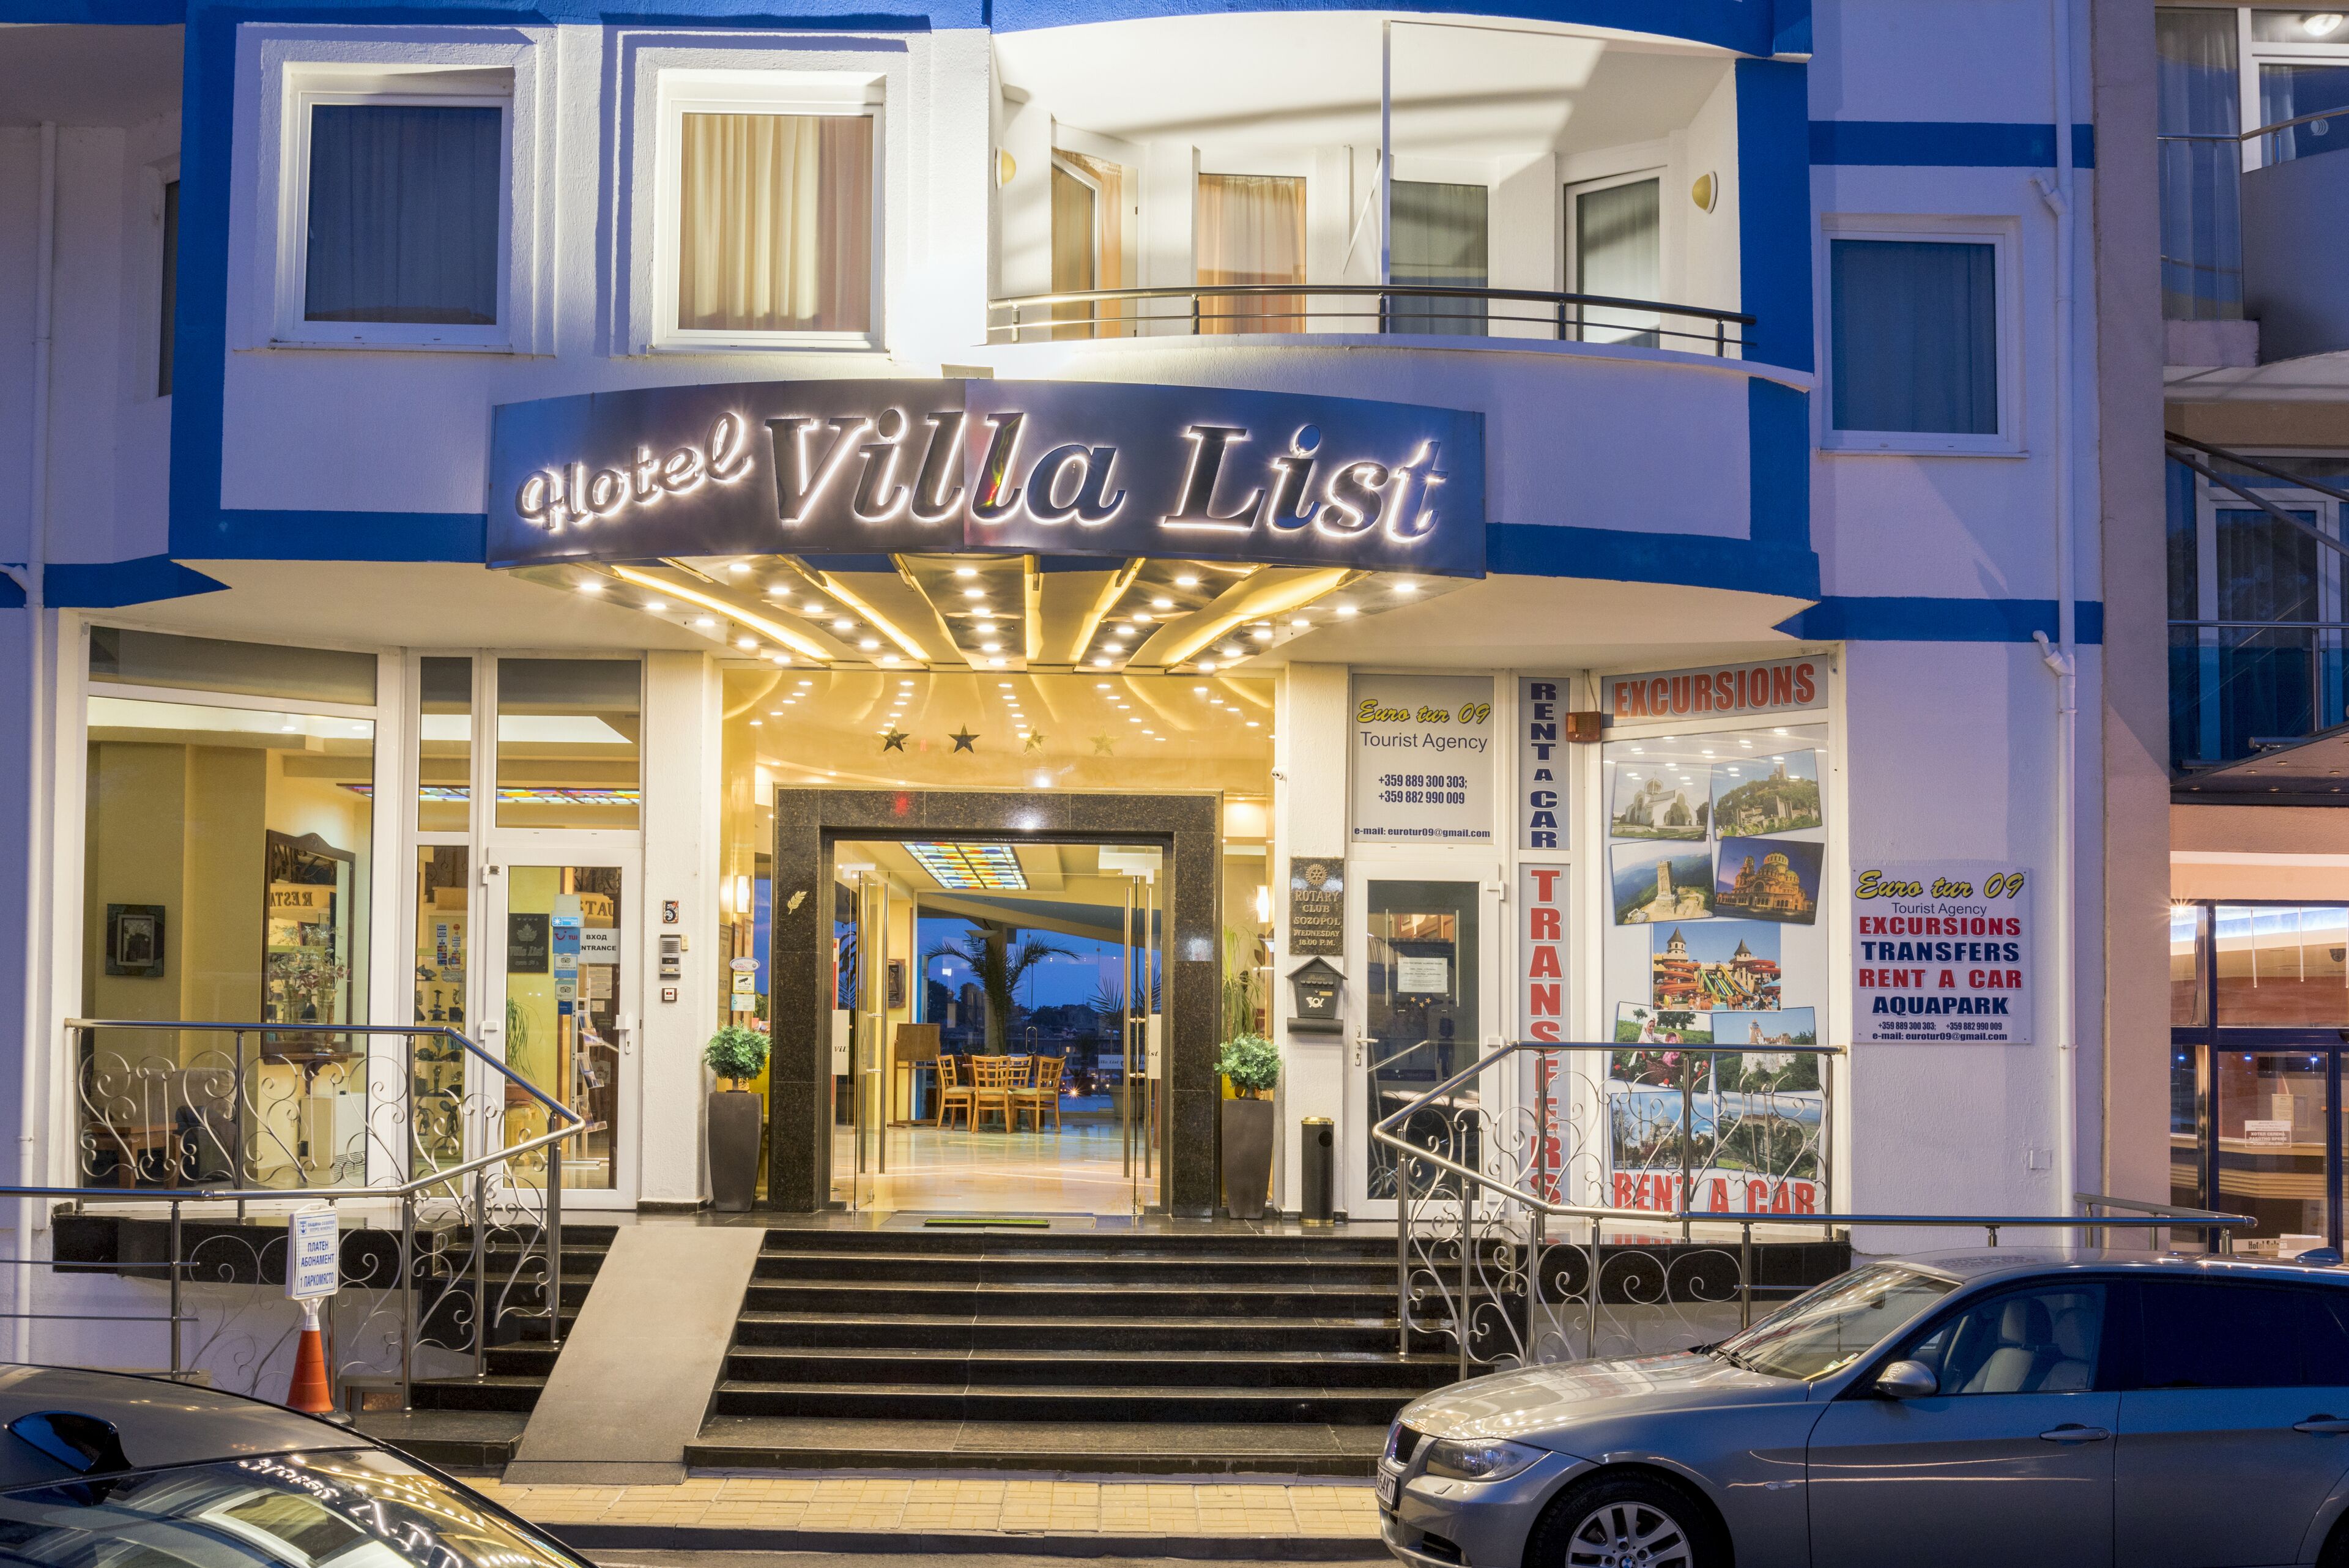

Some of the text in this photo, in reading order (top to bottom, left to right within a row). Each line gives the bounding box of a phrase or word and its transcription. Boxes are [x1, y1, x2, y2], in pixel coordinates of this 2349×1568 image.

[515, 407, 1449, 542] Hotel Villa List
[1614, 663, 1816, 718] EXCURSIONS
[1357, 699, 1491, 724] Euro tur 09
[1360, 732, 1488, 752] Tourist Agency
[1529, 682, 1558, 849] RENT A CAR
[1378, 774, 1468, 789] +359 889 300 303;
[1378, 790, 1465, 804] +359 882 990 009
[1387, 828, 1490, 838] eurotur09@gmail.com
[1855, 870, 2024, 899] Euro tur 09
[1295, 891, 1339, 902] ROTARY
[1891, 902, 1987, 916] Tourist Agency
[1294, 916, 1340, 926] SOZOPOL
[1860, 916, 2021, 935] EXCURSIONS
[1861, 942, 2019, 962] TRANSFERS
[1860, 968, 2022, 989] RENT A CAR
[1872, 996, 2009, 1016] AQUAPARK
[1909, 1022, 1921, 1030] 300
[1922, 1022, 1937, 1031] 303;
[1963, 1022, 1975, 1030] 882
[1976, 1022, 1988, 1030] 990
[1990, 1022, 2002, 1030] 009
[1709, 1178, 1729, 1214] A
[1746, 1180, 1816, 1214] CAR
[308, 1241, 328, 1252] ПЛАТЕН
[301, 1254, 335, 1267] АБОНАМЕНТ
[304, 1272, 334, 1287] ПАРКОМЯСТО
